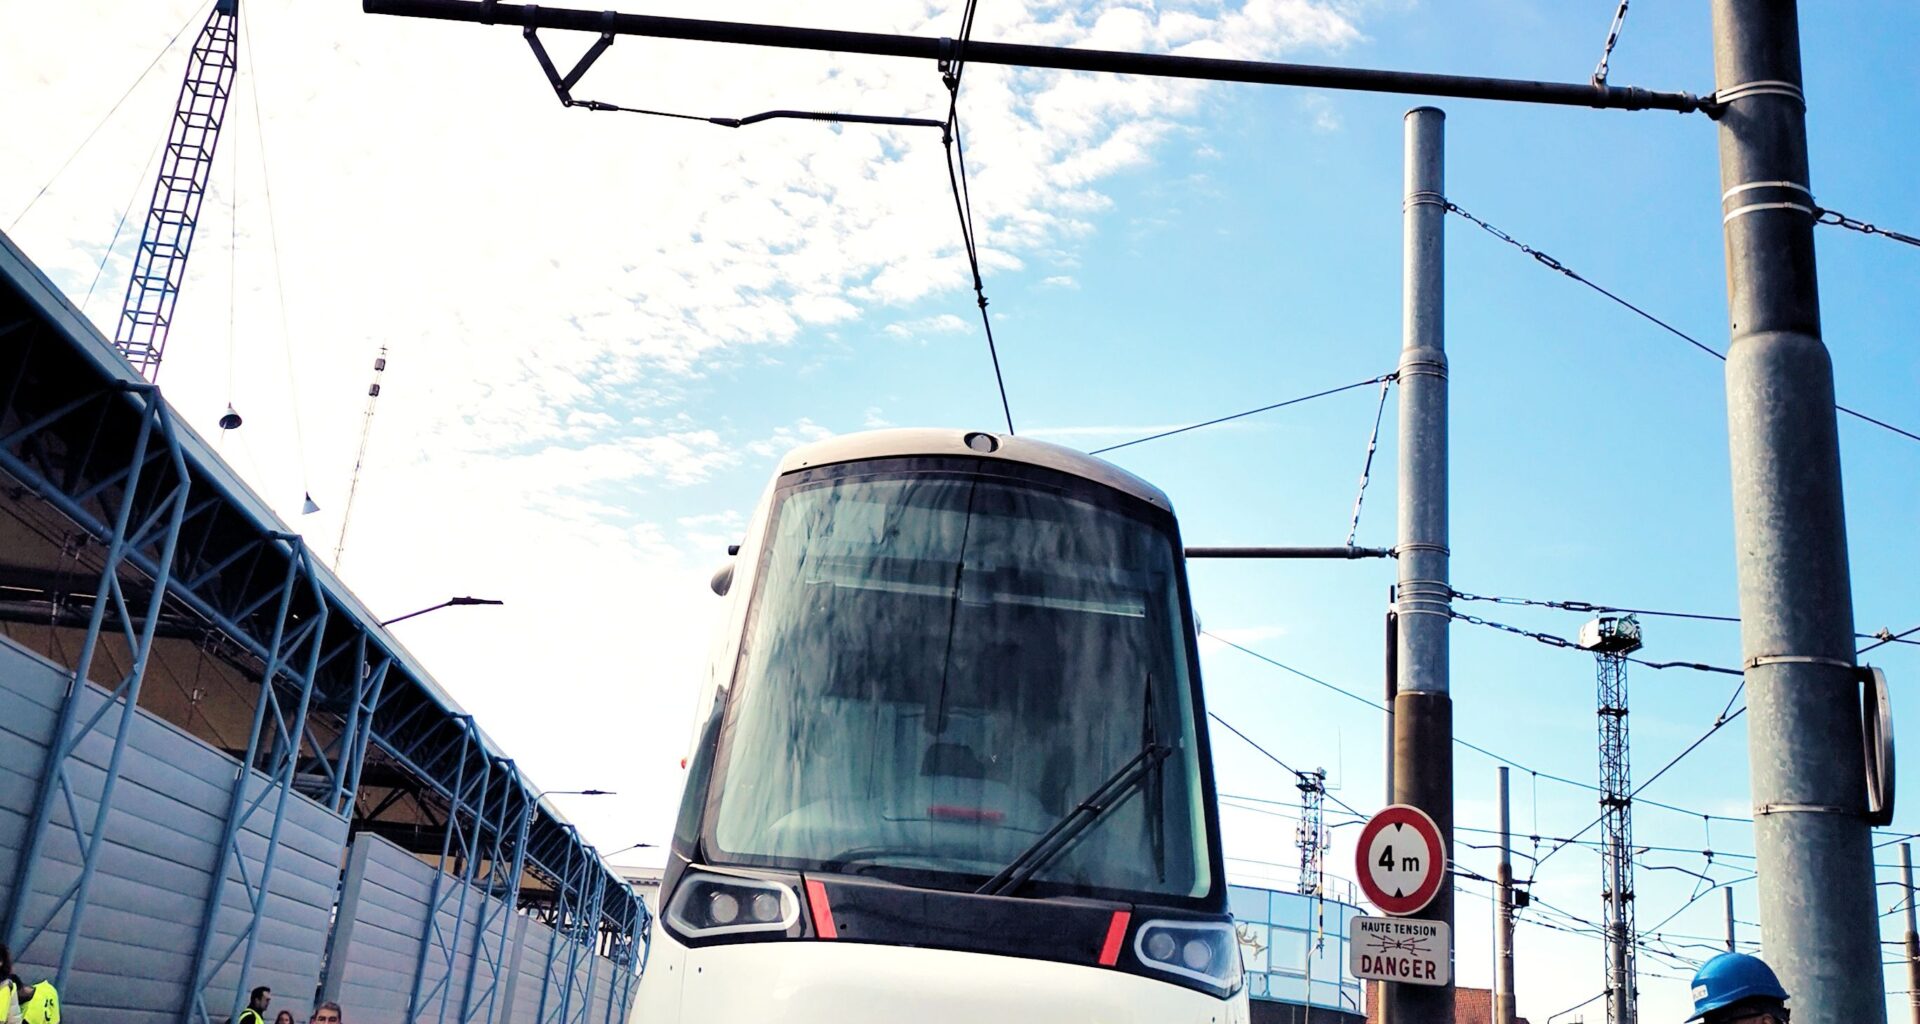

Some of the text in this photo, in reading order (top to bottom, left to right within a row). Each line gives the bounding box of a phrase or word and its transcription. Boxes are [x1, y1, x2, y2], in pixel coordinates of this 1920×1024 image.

[1378, 844, 1420, 872] 4 m
[1361, 921, 1437, 936] HAUTE TENSION
[1361, 954, 1437, 980] DANGER
